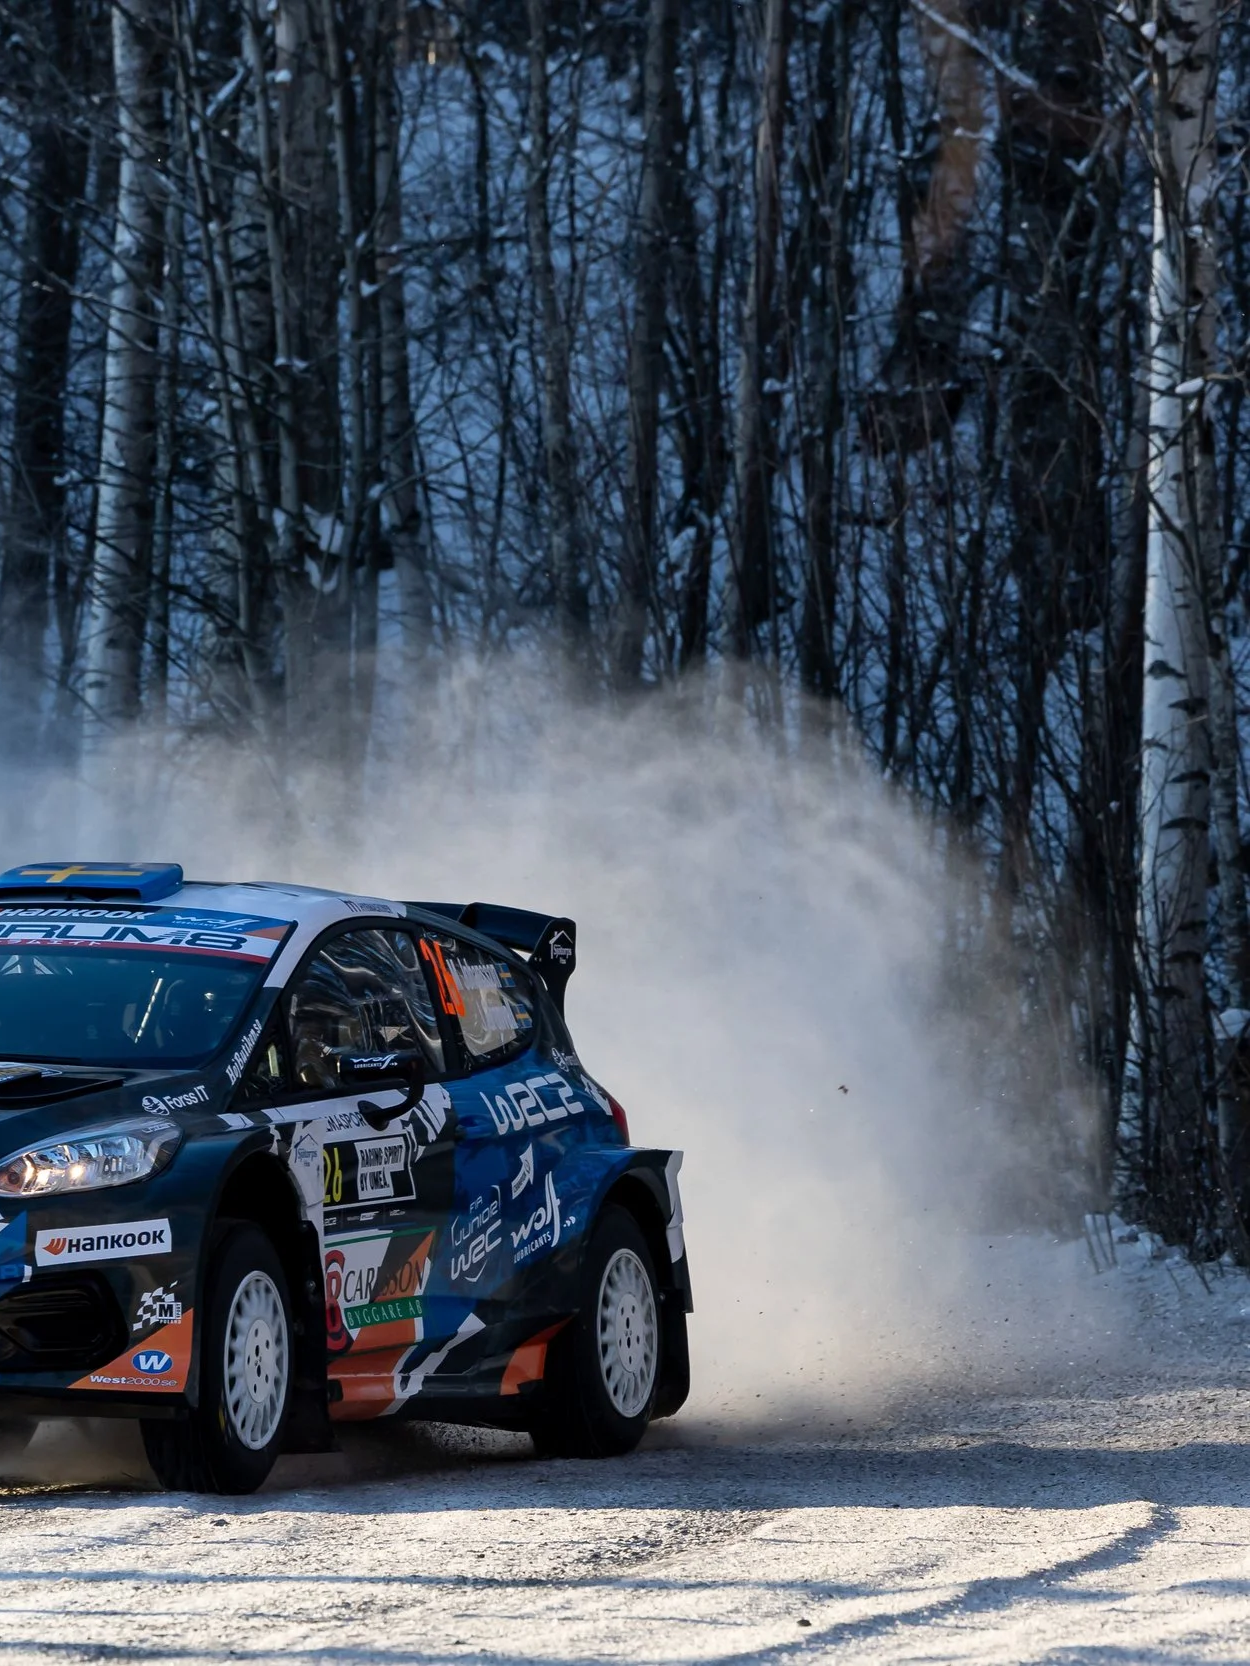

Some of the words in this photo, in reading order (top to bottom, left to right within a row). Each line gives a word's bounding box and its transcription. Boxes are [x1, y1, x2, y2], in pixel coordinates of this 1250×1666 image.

[163, 1091, 199, 1110] Forss
[193, 1084, 210, 1102] IT
[479, 1073, 585, 1136] WRC2
[359, 1146, 383, 1169] RACING
[383, 1144, 403, 1166] SPIRIT
[360, 1172, 368, 1192] BY
[469, 1195, 483, 1214] FIA
[510, 1170, 561, 1248] wolf
[454, 1201, 499, 1247] JUNIOR
[451, 1218, 502, 1281] WRC
[513, 1231, 552, 1264] LUBRICANTS
[158, 1303, 174, 1318] M
[346, 1302, 403, 1327] BYGGARE
[408, 1299, 423, 1316] AB
[138, 1353, 170, 1370] W
